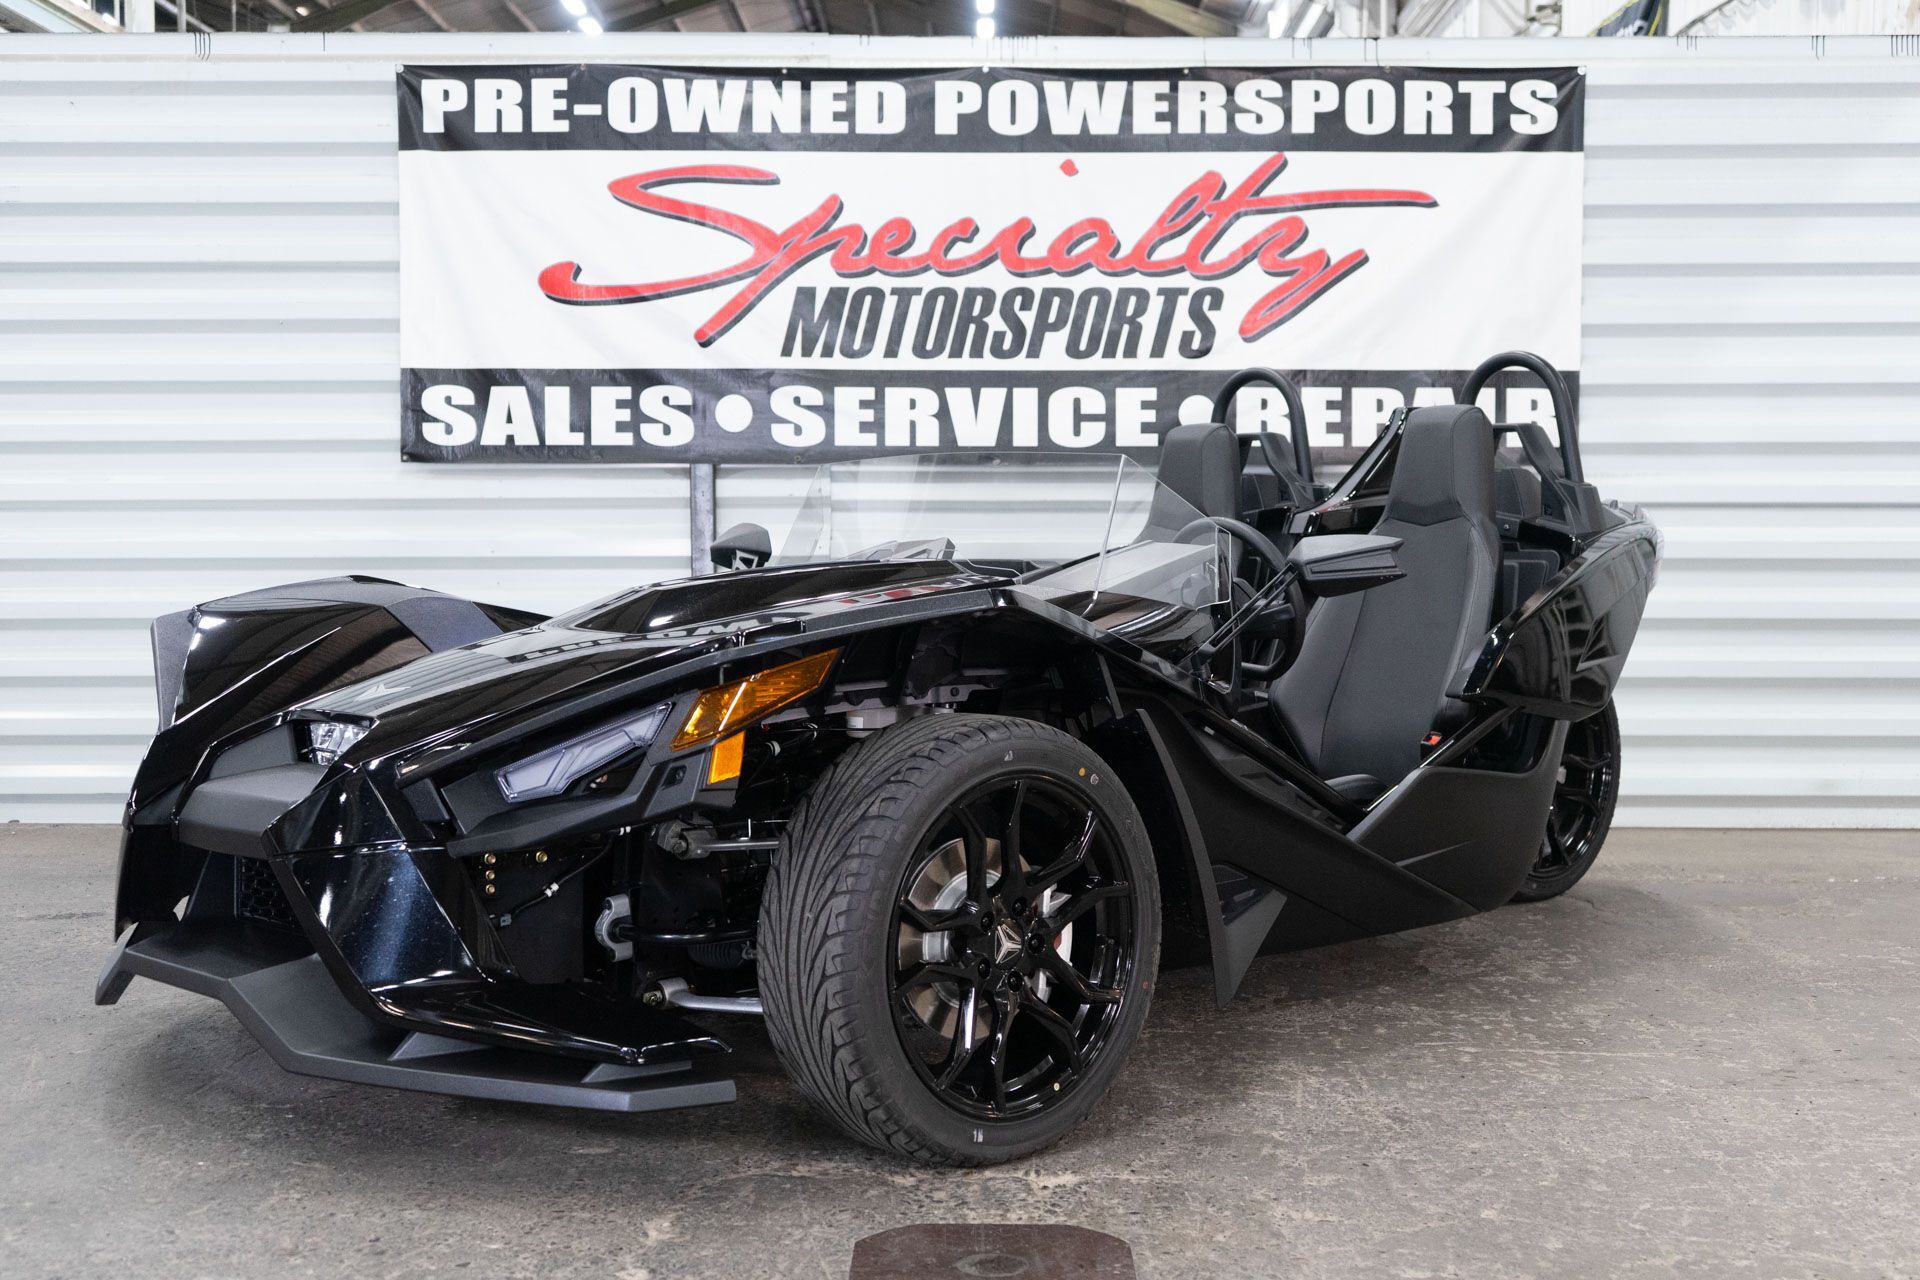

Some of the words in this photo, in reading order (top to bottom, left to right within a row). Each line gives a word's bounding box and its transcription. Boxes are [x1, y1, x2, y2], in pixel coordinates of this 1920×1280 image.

[420, 76, 907, 136] PRE-OWNED
[934, 78, 1559, 136] POWERSPORTS
[538, 152, 1438, 348] Specialty
[780, 286, 1225, 361] MOTORSPORTS
[420, 384, 696, 448] SALES
[769, 384, 1159, 449] SERVICE
